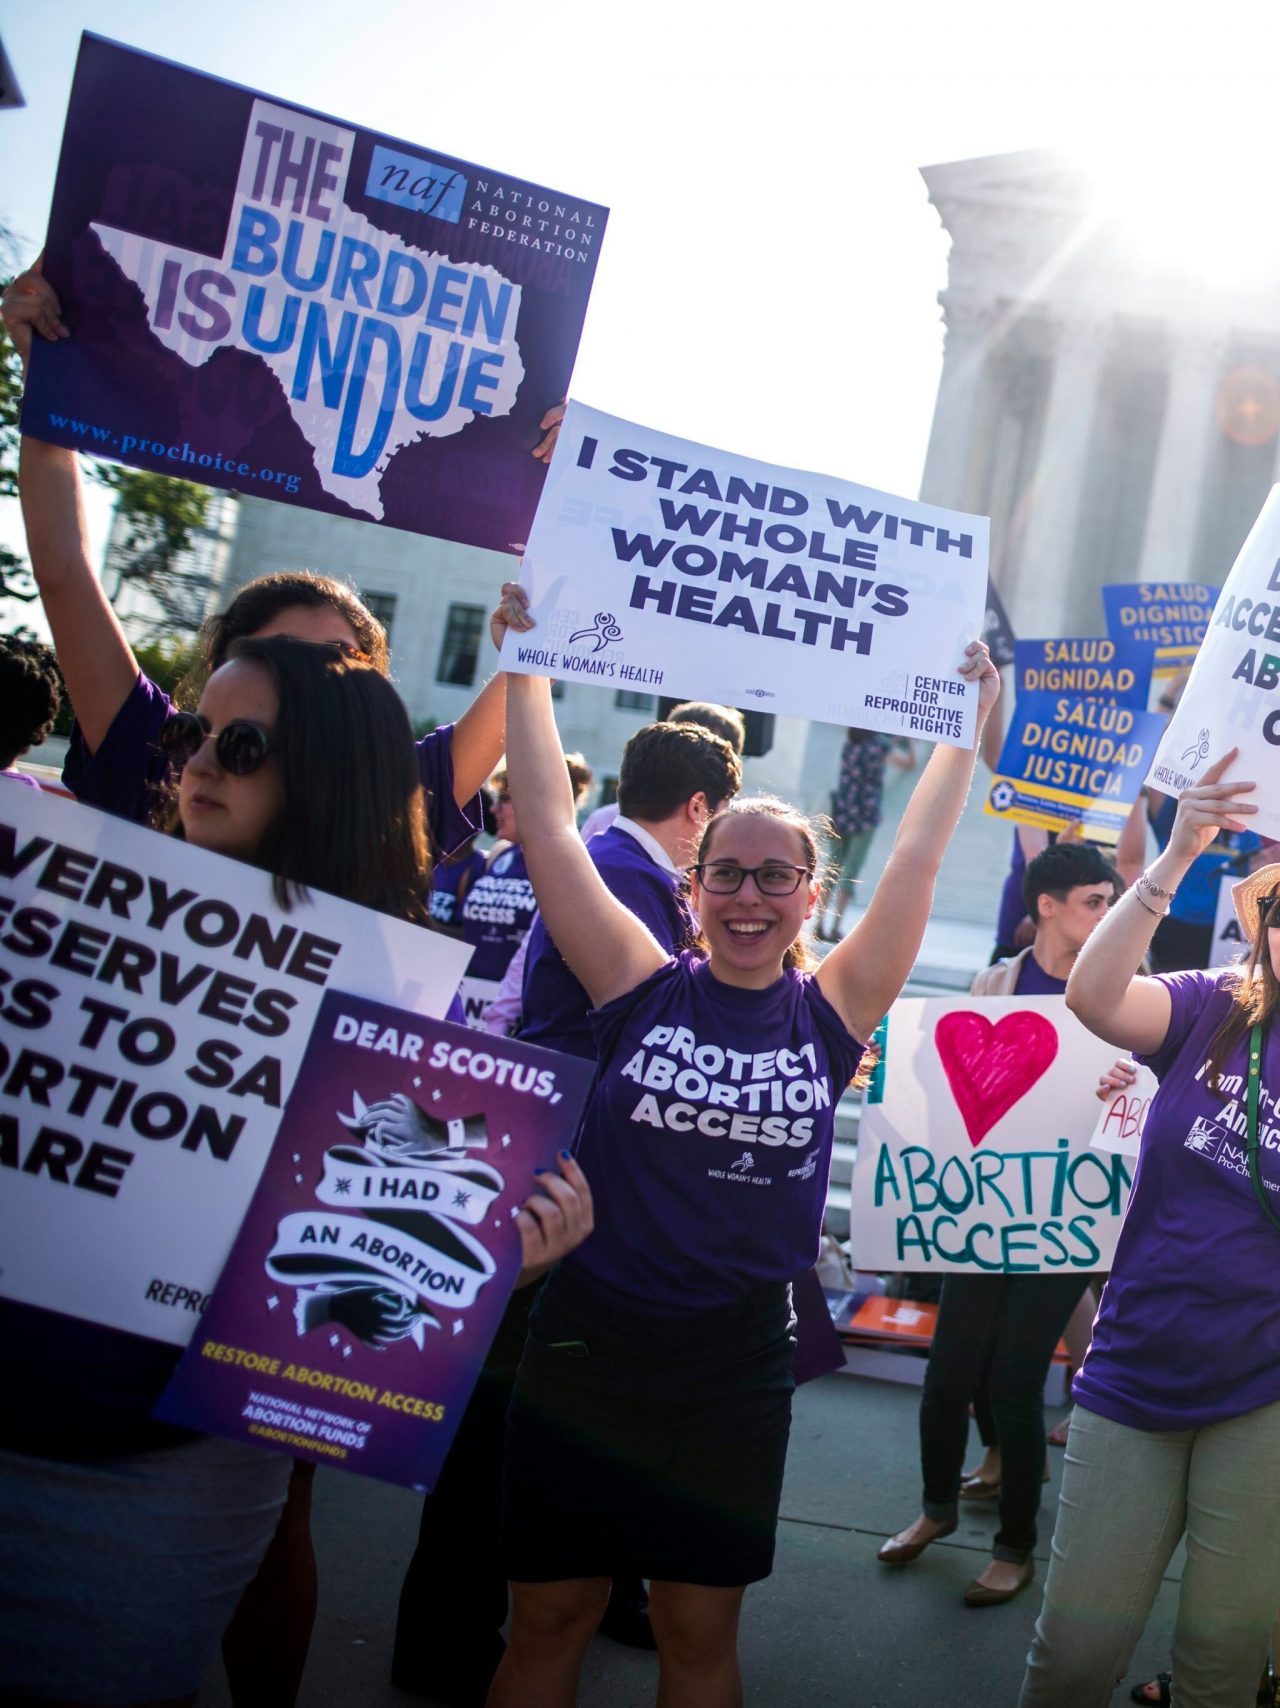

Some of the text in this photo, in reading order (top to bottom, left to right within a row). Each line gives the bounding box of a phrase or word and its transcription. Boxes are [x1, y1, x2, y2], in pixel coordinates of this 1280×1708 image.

[254, 120, 343, 222] THE
[380, 164, 460, 215] naf
[470, 199, 594, 247] ABORTION
[474, 180, 597, 230] NATIONAL
[467, 218, 589, 264] FEDERATION
[231, 205, 521, 347] BURDEN
[153, 259, 505, 480] IS UNDUE
[48, 411, 302, 495] www.prochoice.org
[576, 435, 973, 559] I STAND WITH
[658, 497, 880, 572] WHOLE
[610, 526, 910, 616] WOMAN'S
[1138, 584, 1210, 603] SALUD
[628, 574, 874, 656] HEALTH
[517, 647, 664, 685] WHOLE WOMAN'S HEALTH
[1044, 640, 1116, 663] SALUD
[912, 690, 939, 706] FOR
[914, 676, 966, 697] CENTER
[1025, 668, 1136, 692] DIGNIDAD
[864, 694, 964, 724] REPRODUCTIVE
[909, 717, 962, 739] RIGHTS
[1054, 698, 1134, 735] SALUD
[1021, 722, 1143, 769] DIGNIDAD
[1023, 753, 1124, 797] JUSTICIA
[0, 967, 61, 1031] S
[79, 996, 176, 1066] TO
[333, 1014, 563, 1105] DEAR SCOTUS,
[641, 1024, 817, 1081] PROTECT
[0, 1042, 247, 1162] RTION
[620, 1049, 831, 1112] ABORTION
[630, 1093, 815, 1148] ACCESS
[363, 1176, 440, 1201] I HAD
[708, 1168, 725, 1179] WHOLE
[752, 1175, 772, 1185] HEALTH
[300, 1225, 466, 1296] AN ABORTION
[897, 1214, 1100, 1273] ACCESS
[201, 1341, 446, 1422] RESTORE ABORTION ACCESS
[241, 1405, 366, 1449] ABORTION FUNDS
[248, 1391, 372, 1435] NATIONAL NETWORK OF
[248, 1424, 348, 1459] @ABORTIONFUNDS
